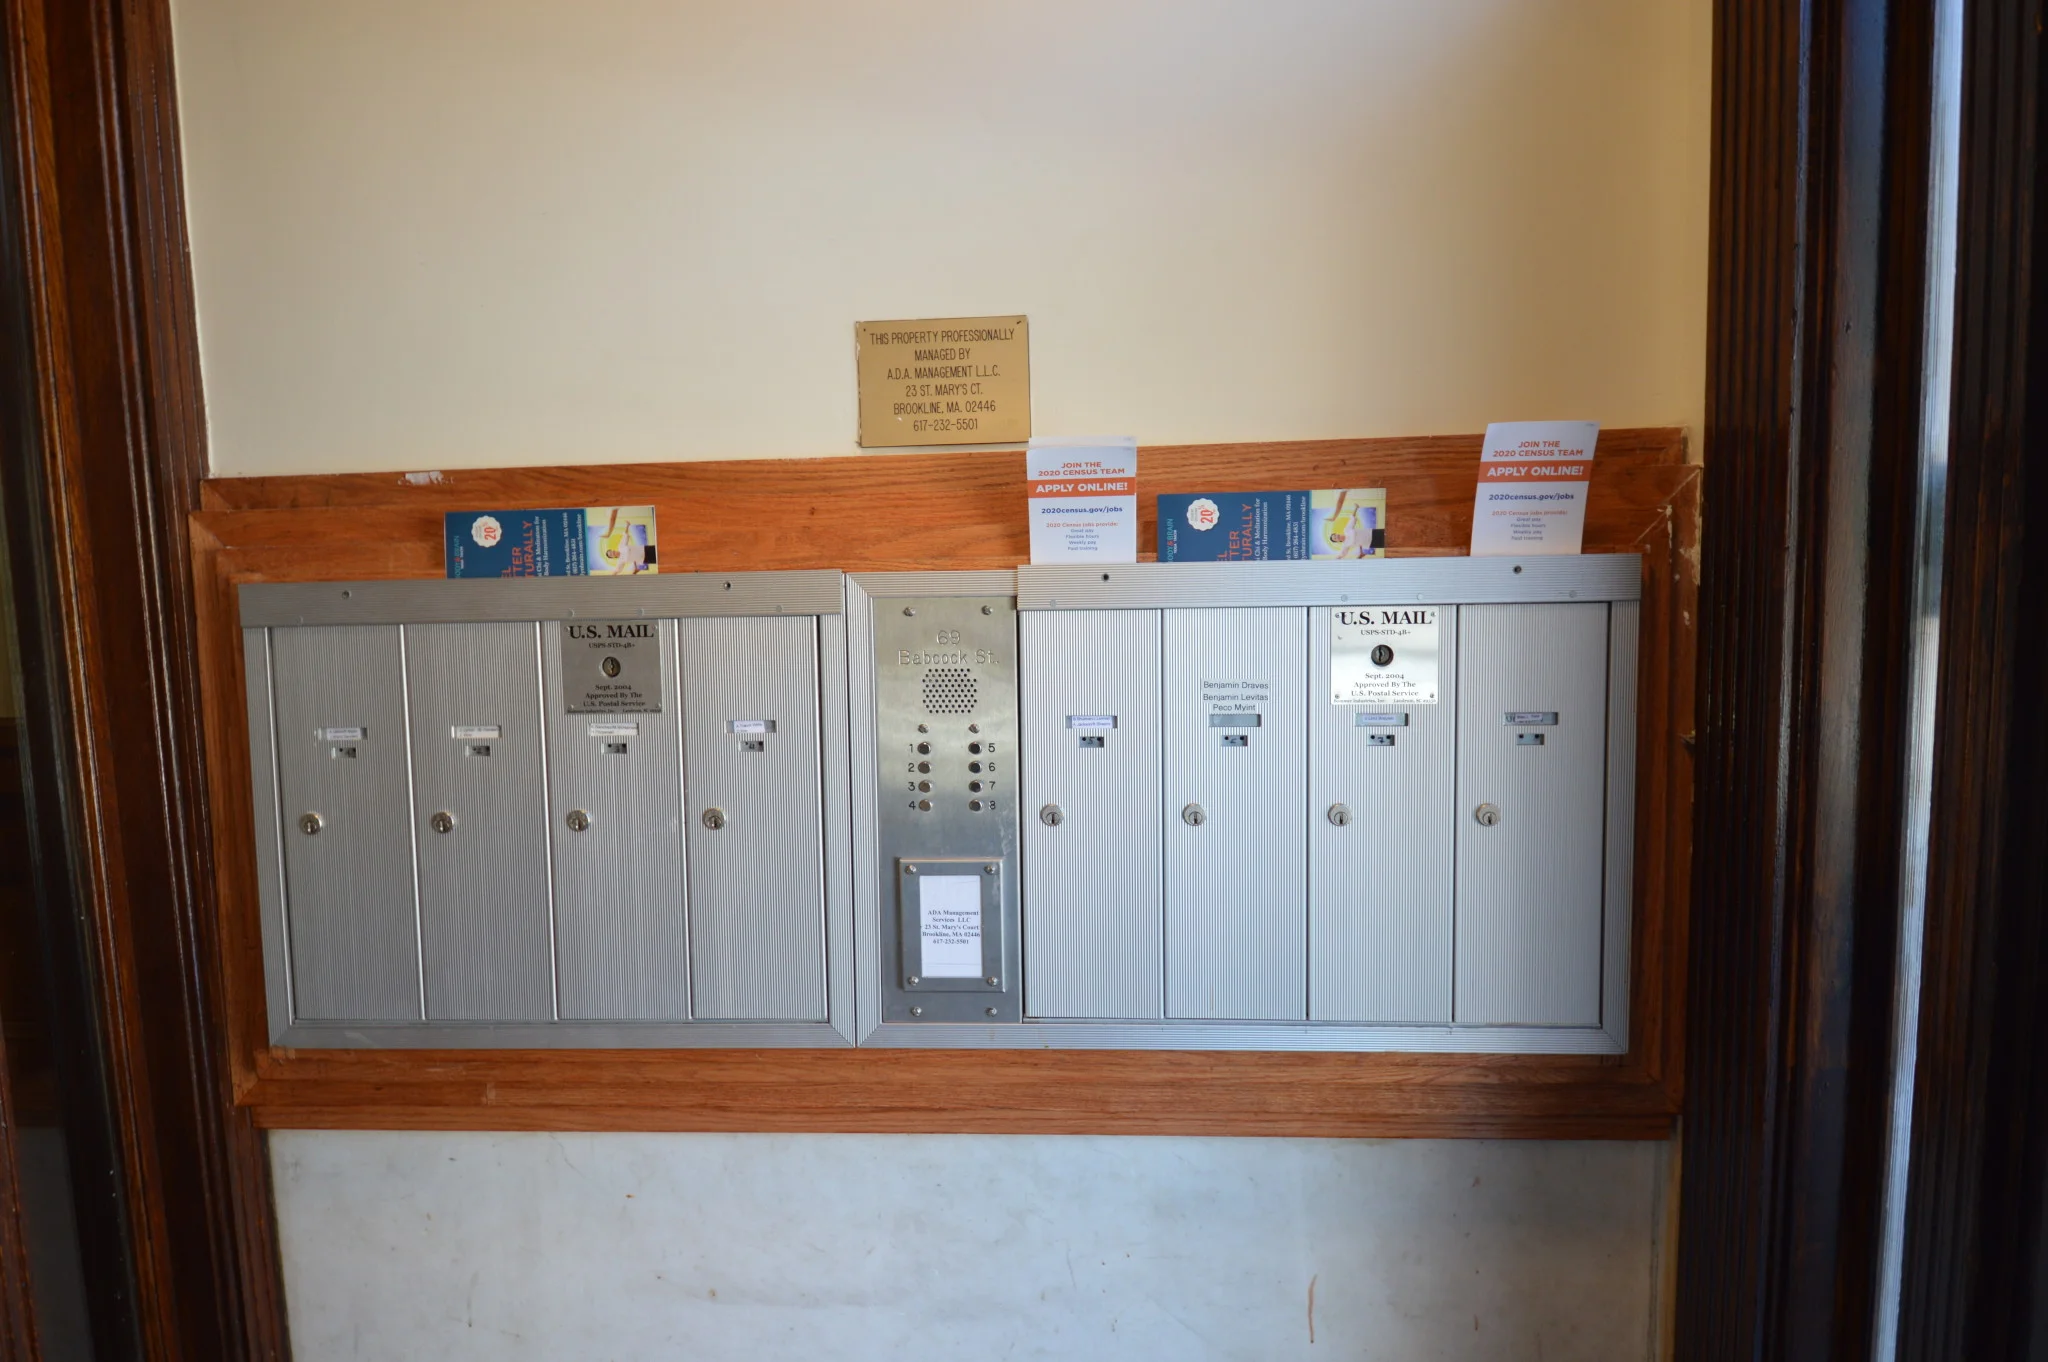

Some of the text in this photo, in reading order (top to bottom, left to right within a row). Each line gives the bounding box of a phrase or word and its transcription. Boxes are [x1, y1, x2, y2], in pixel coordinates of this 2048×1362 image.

[870, 328, 1014, 345] THIS PROPERTY PROFESSIONALLY
[915, 348, 971, 361] MANAGED BY
[887, 365, 1000, 380] A.D.A. MANAGEMENT L.L.C.
[906, 383, 983, 396] 23 ST. MARY'S CT.
[894, 400, 996, 415] BROOKLINE, MA. 02446
[913, 418, 978, 431] 617-232-5501
[1487, 466, 1583, 476] APPLY ONLINE!
[1036, 482, 1128, 493] APPLY ONLINE!
[1340, 611, 1432, 625] U.S. MAIL
[569, 625, 654, 639] U.S. MAIL
[936, 630, 960, 645] 69
[898, 650, 968, 665] Babcock
[1204, 681, 1239, 689] Benjamin
[910, 744, 913, 753] 1
[989, 743, 995, 752] 5
[908, 763, 914, 772] 2
[989, 763, 995, 772] 6
[908, 782, 915, 791] 3
[989, 781, 996, 790] 7
[909, 801, 916, 810] 4
